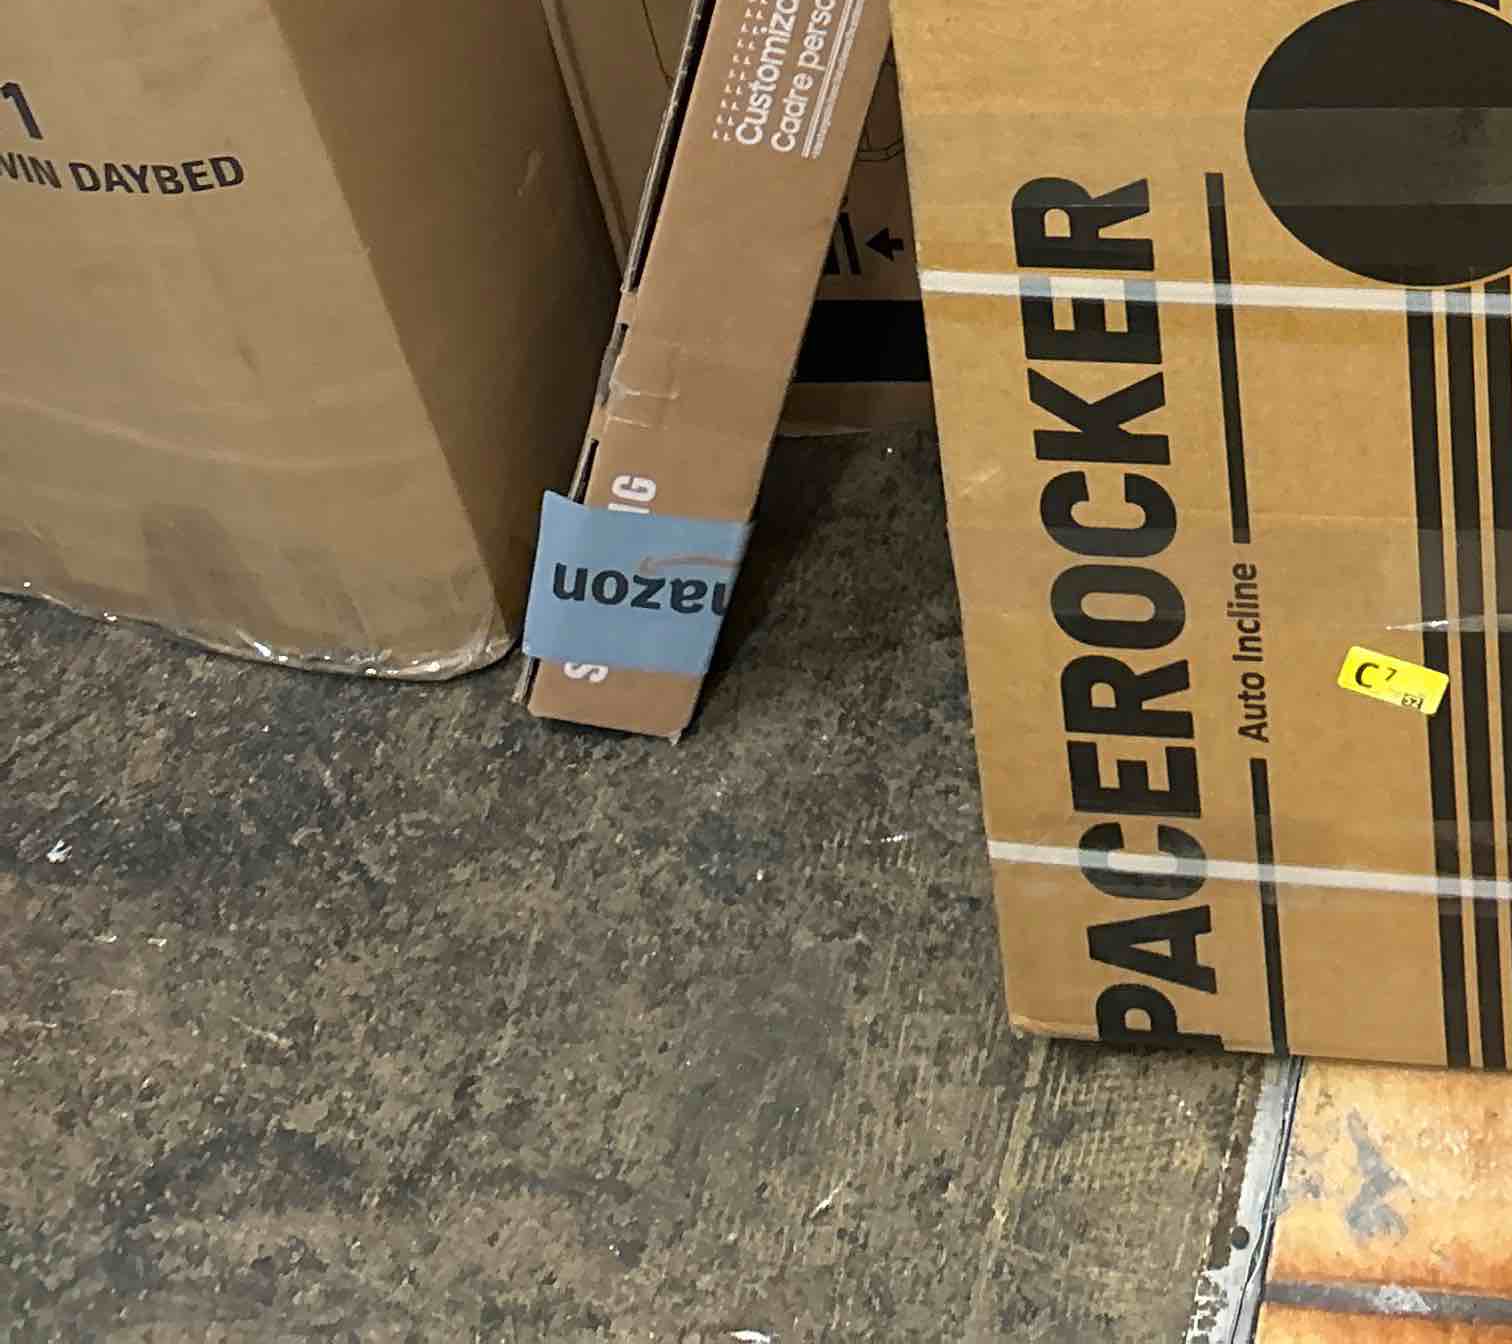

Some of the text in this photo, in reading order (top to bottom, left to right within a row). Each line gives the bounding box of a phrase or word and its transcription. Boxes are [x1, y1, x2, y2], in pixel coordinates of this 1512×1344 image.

[68, 155, 245, 195] DAYBED
[770, 72, 814, 153] Cadre
[1011, 175, 1225, 1054] PACEROCKER
[1226, 562, 1269, 744] Auto Incline
